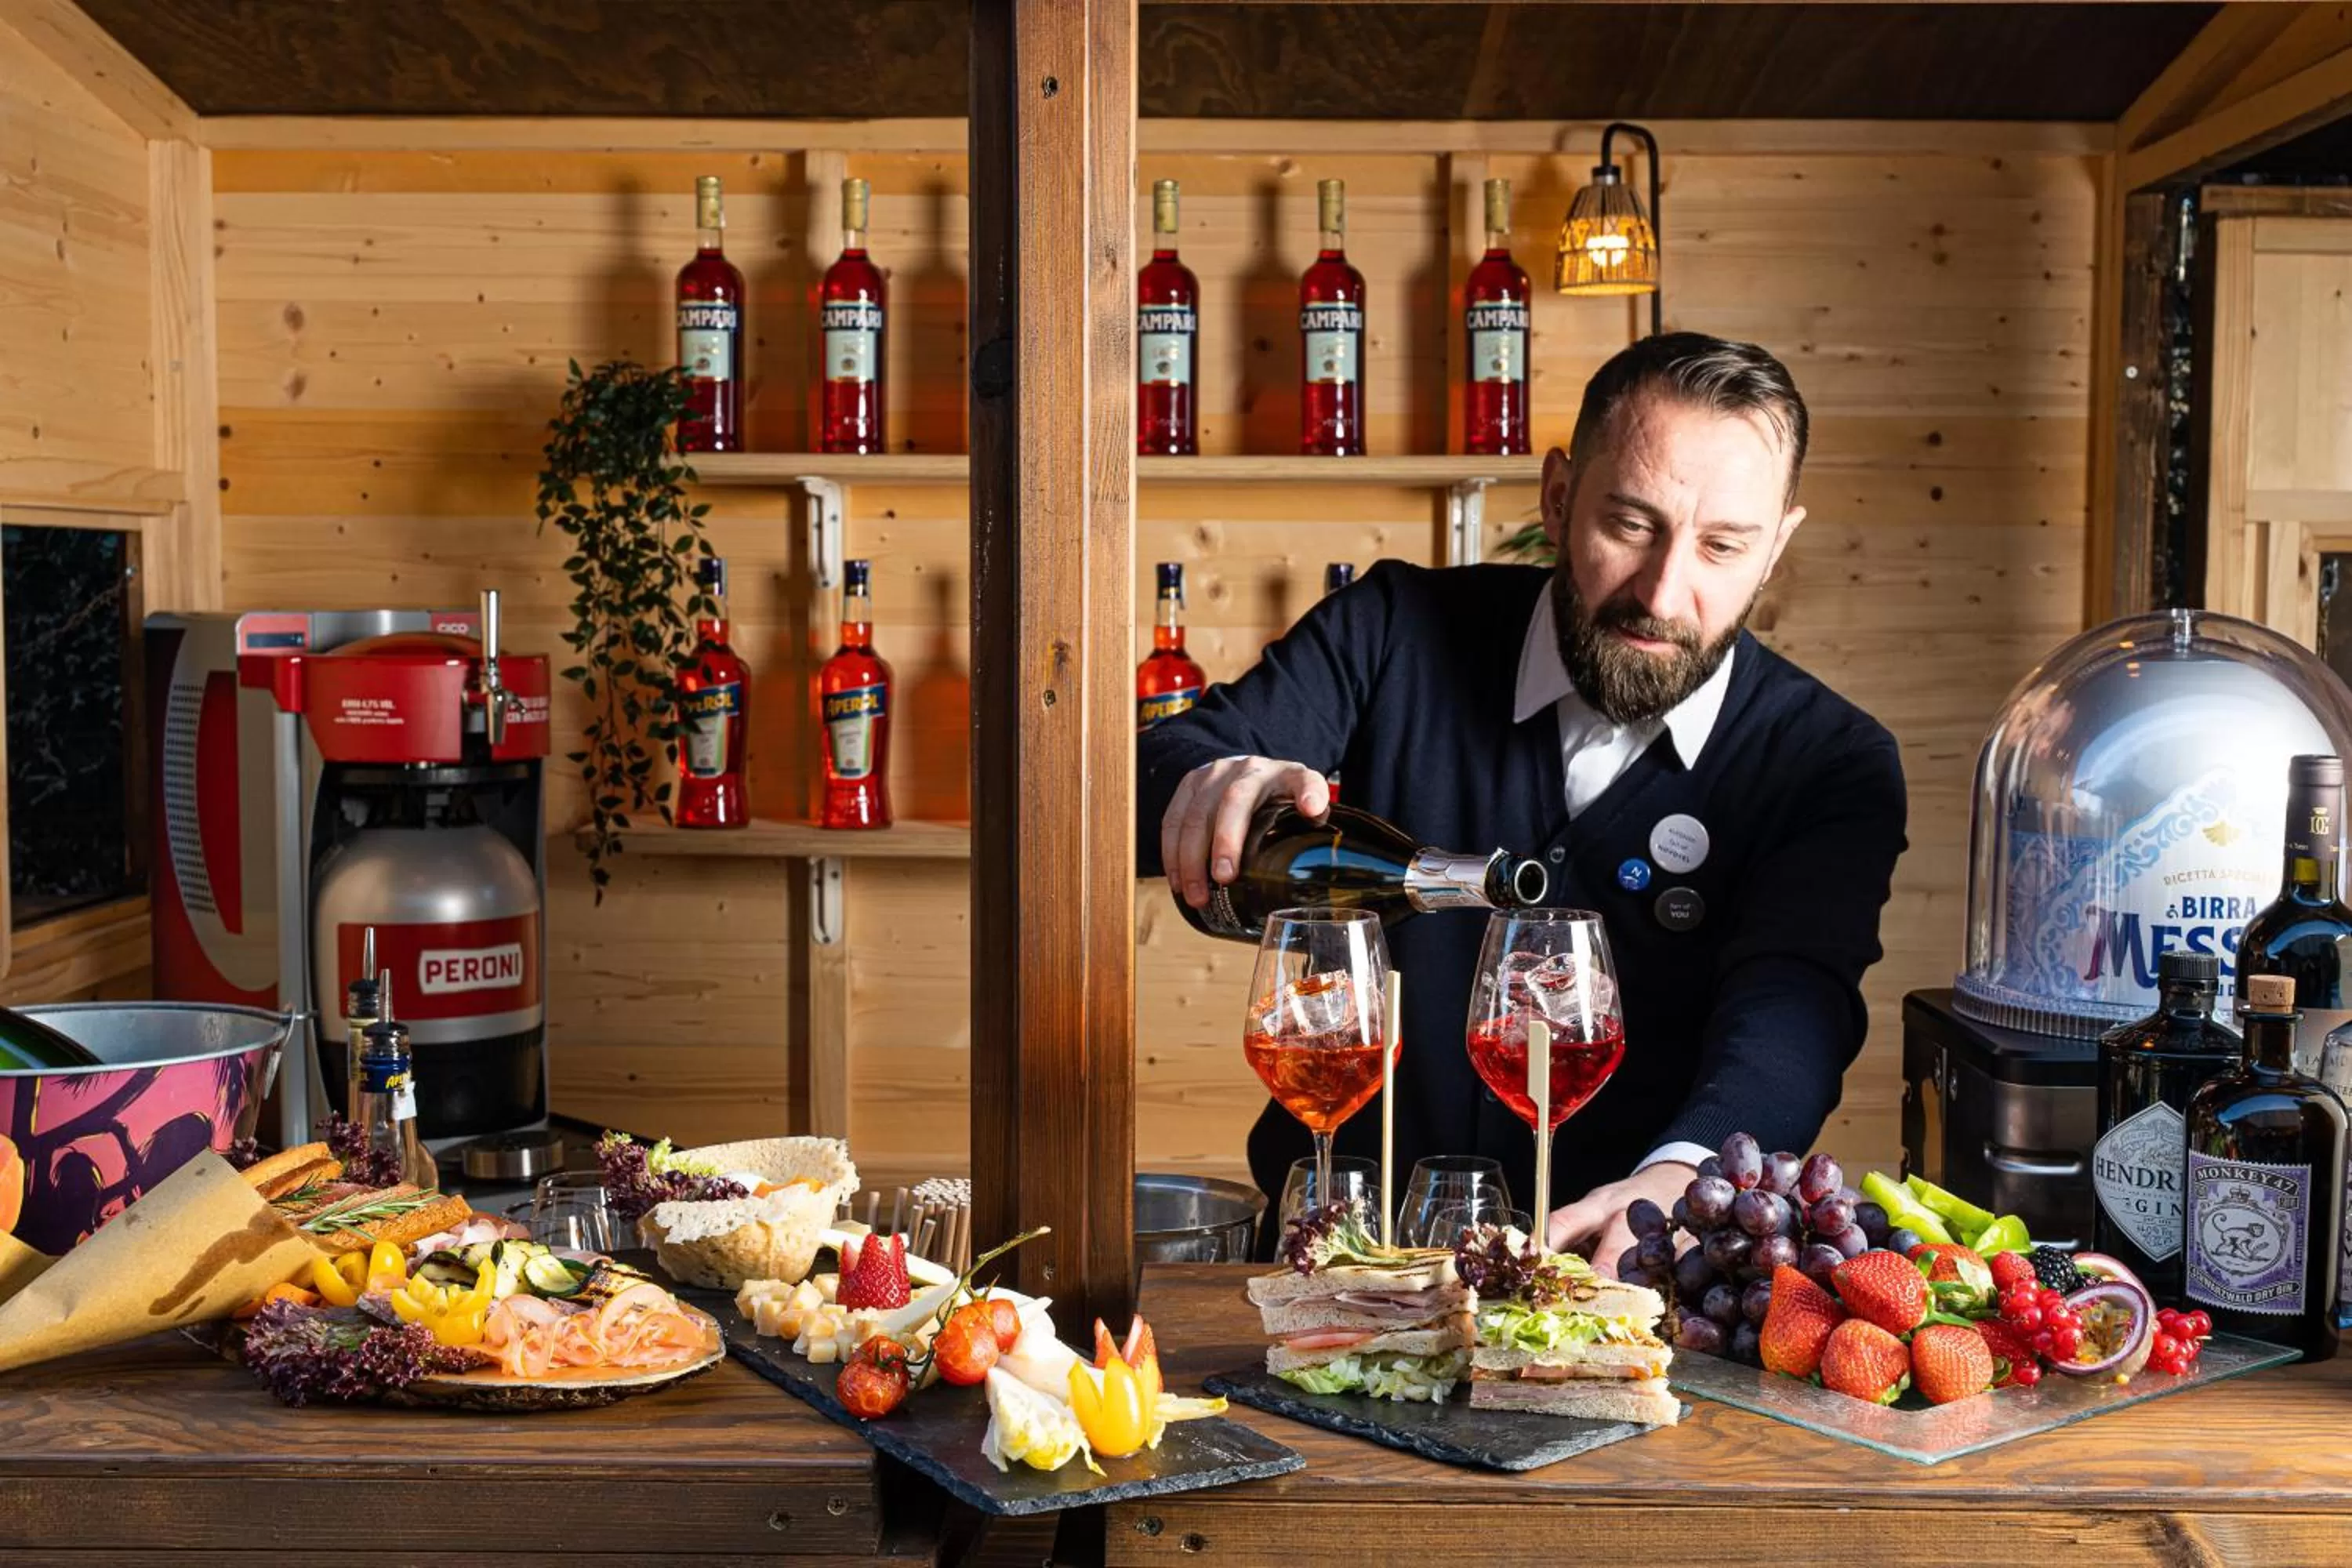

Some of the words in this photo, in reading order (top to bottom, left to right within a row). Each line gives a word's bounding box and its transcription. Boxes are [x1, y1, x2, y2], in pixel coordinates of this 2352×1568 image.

[1301, 310, 1363, 328] CAMPARI
[1468, 309, 1530, 328] CAMPARI
[828, 693, 879, 716] APEROL
[2182, 896, 2256, 920] BIRRA
[2084, 904, 2242, 989] MESS
[426, 953, 519, 984] PERONI
[2197, 1167, 2270, 1185] MONKEY
[2274, 1178, 2296, 1191] 47
[2255, 1288, 2274, 1301] DRY
[2276, 1284, 2294, 1294] GIN
